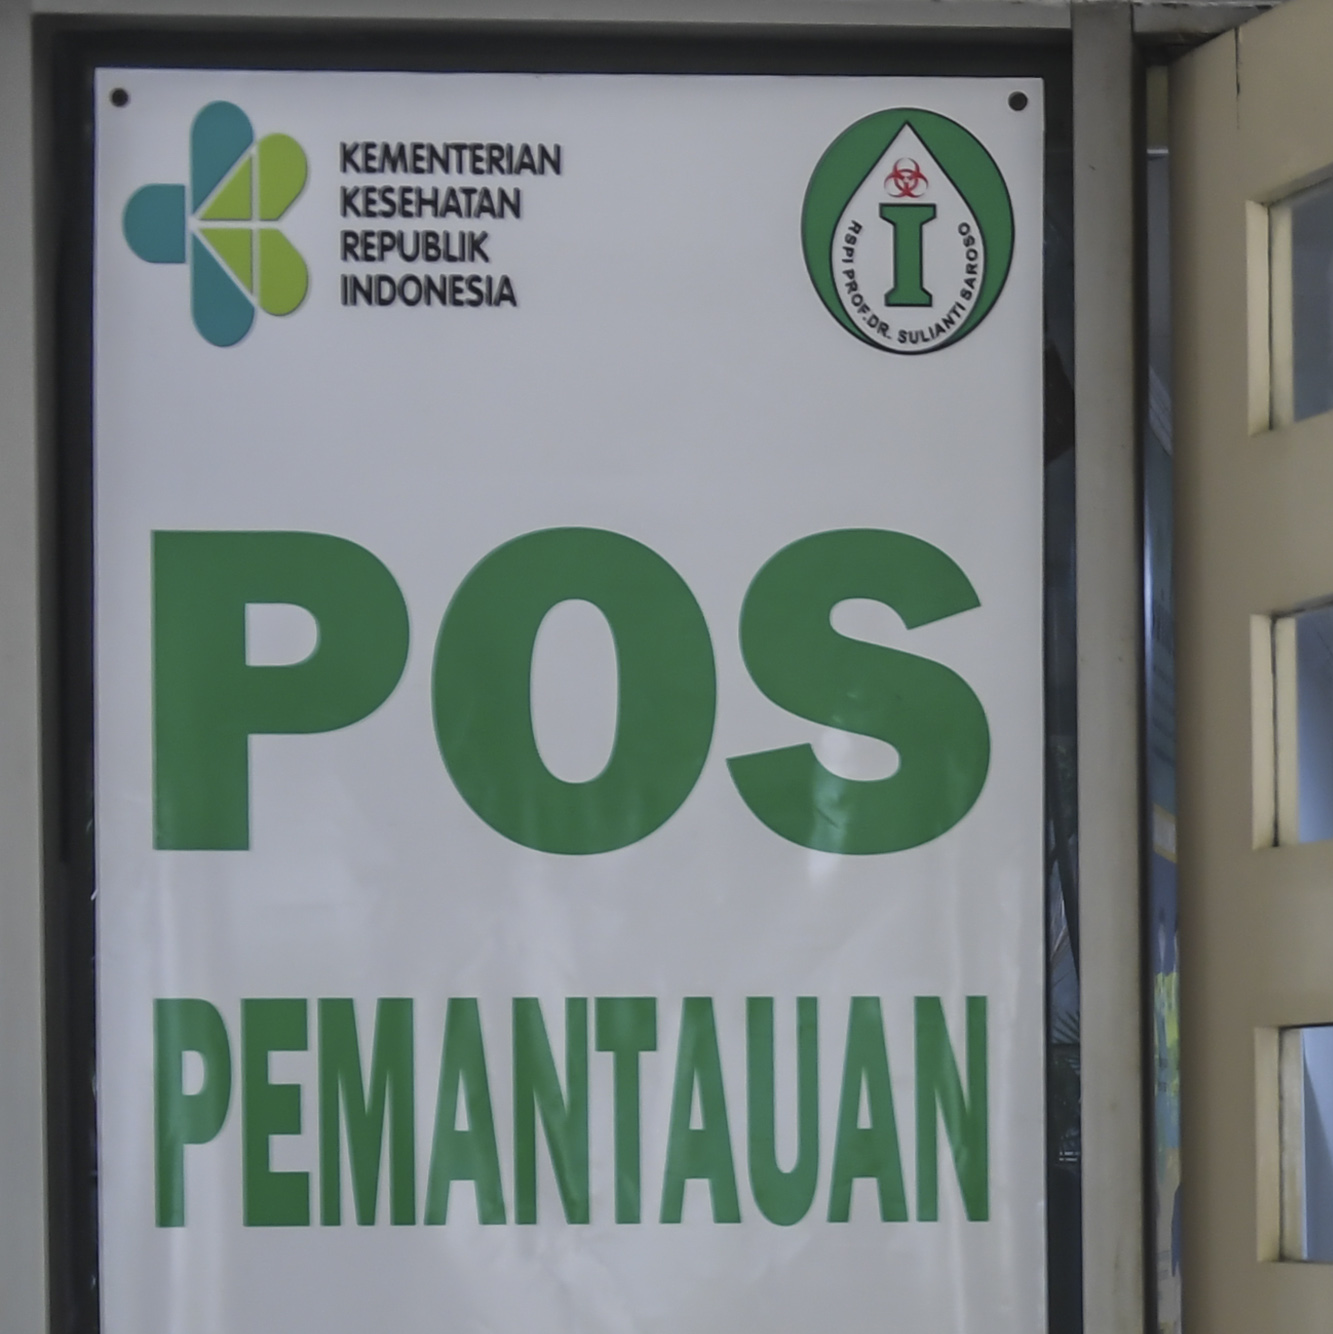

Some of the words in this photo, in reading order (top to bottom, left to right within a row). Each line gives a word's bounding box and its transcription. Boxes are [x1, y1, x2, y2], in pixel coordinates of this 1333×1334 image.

[339, 140, 562, 177] KEMENTERIAN
[339, 186, 522, 221] KESEHATAN
[339, 230, 490, 265] REPUBLIK
[339, 274, 518, 309] INDONESIA
[841, 219, 863, 263] RSPI
[897, 301, 967, 345] SULIANTI
[957, 221, 979, 301] SAROSO
[150, 526, 991, 856] POS
[153, 995, 990, 1228] PEMANTAUAN
